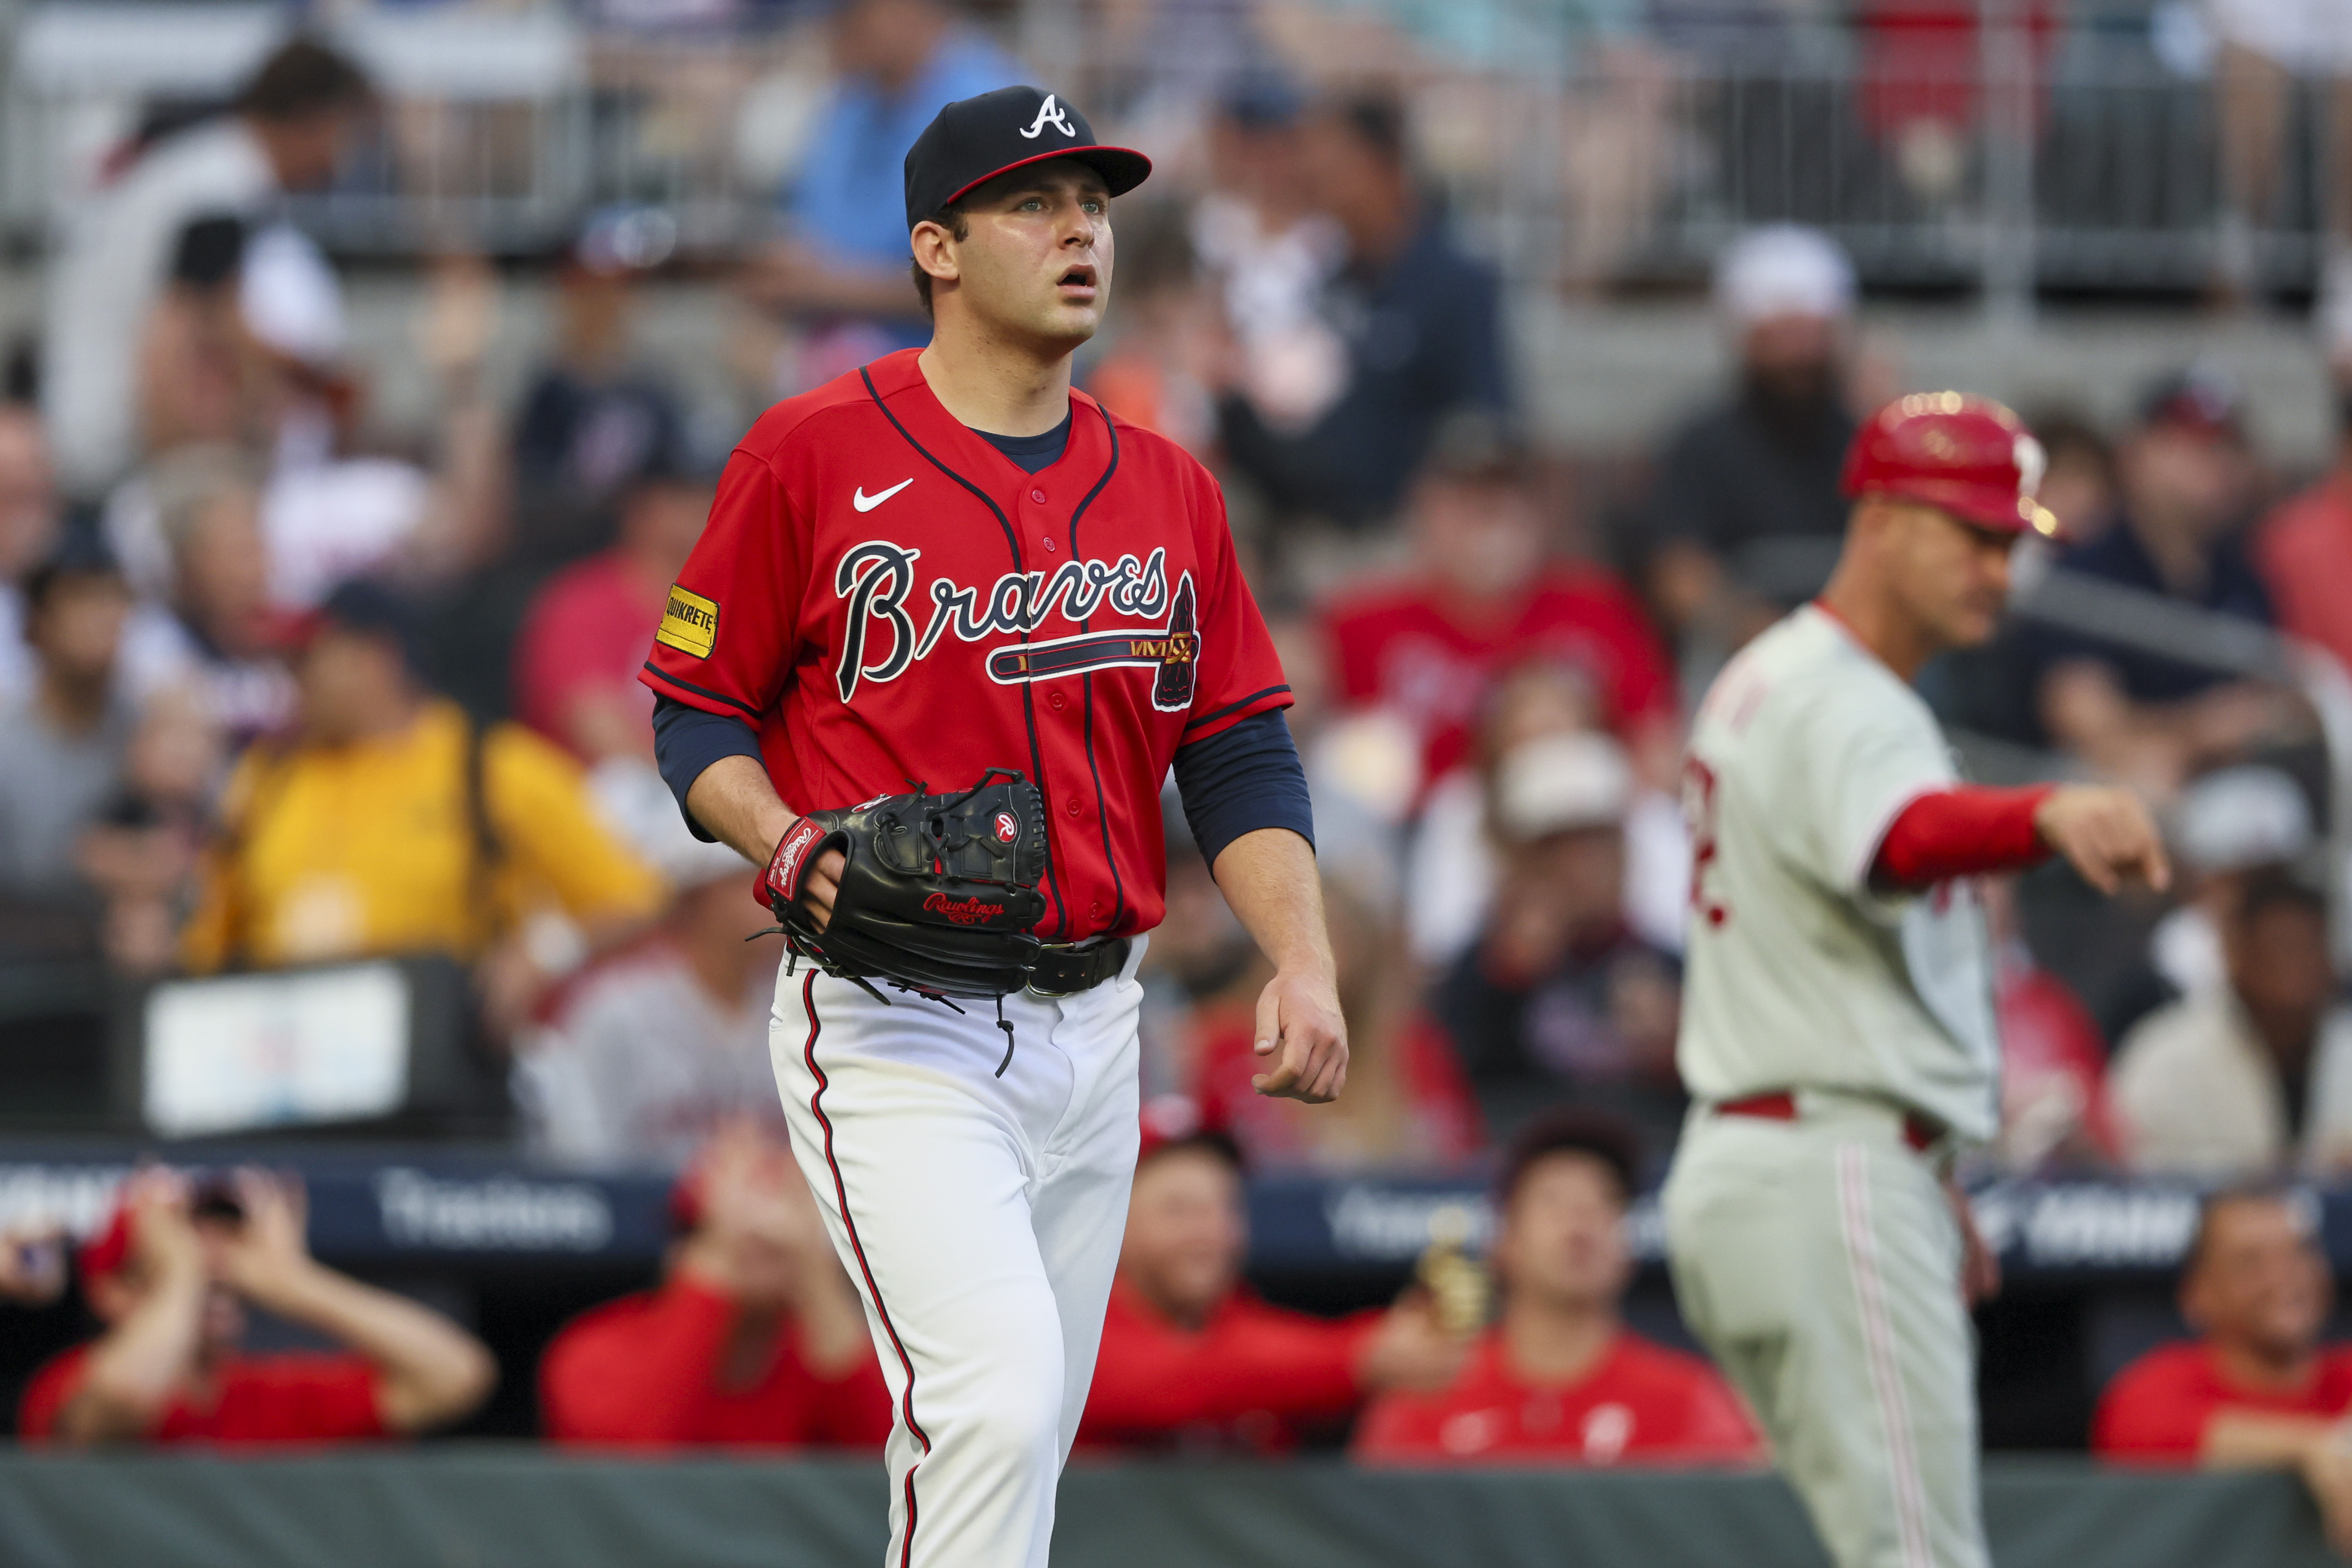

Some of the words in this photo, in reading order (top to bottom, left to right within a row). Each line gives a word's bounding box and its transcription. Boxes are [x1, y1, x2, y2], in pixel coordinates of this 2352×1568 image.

[1019, 94, 1076, 139] A
[666, 597, 714, 631] QUIKRETE
[835, 540, 1168, 704] Braves
[779, 827, 812, 888] Rawlings
[923, 892, 1005, 924] Rawlings
